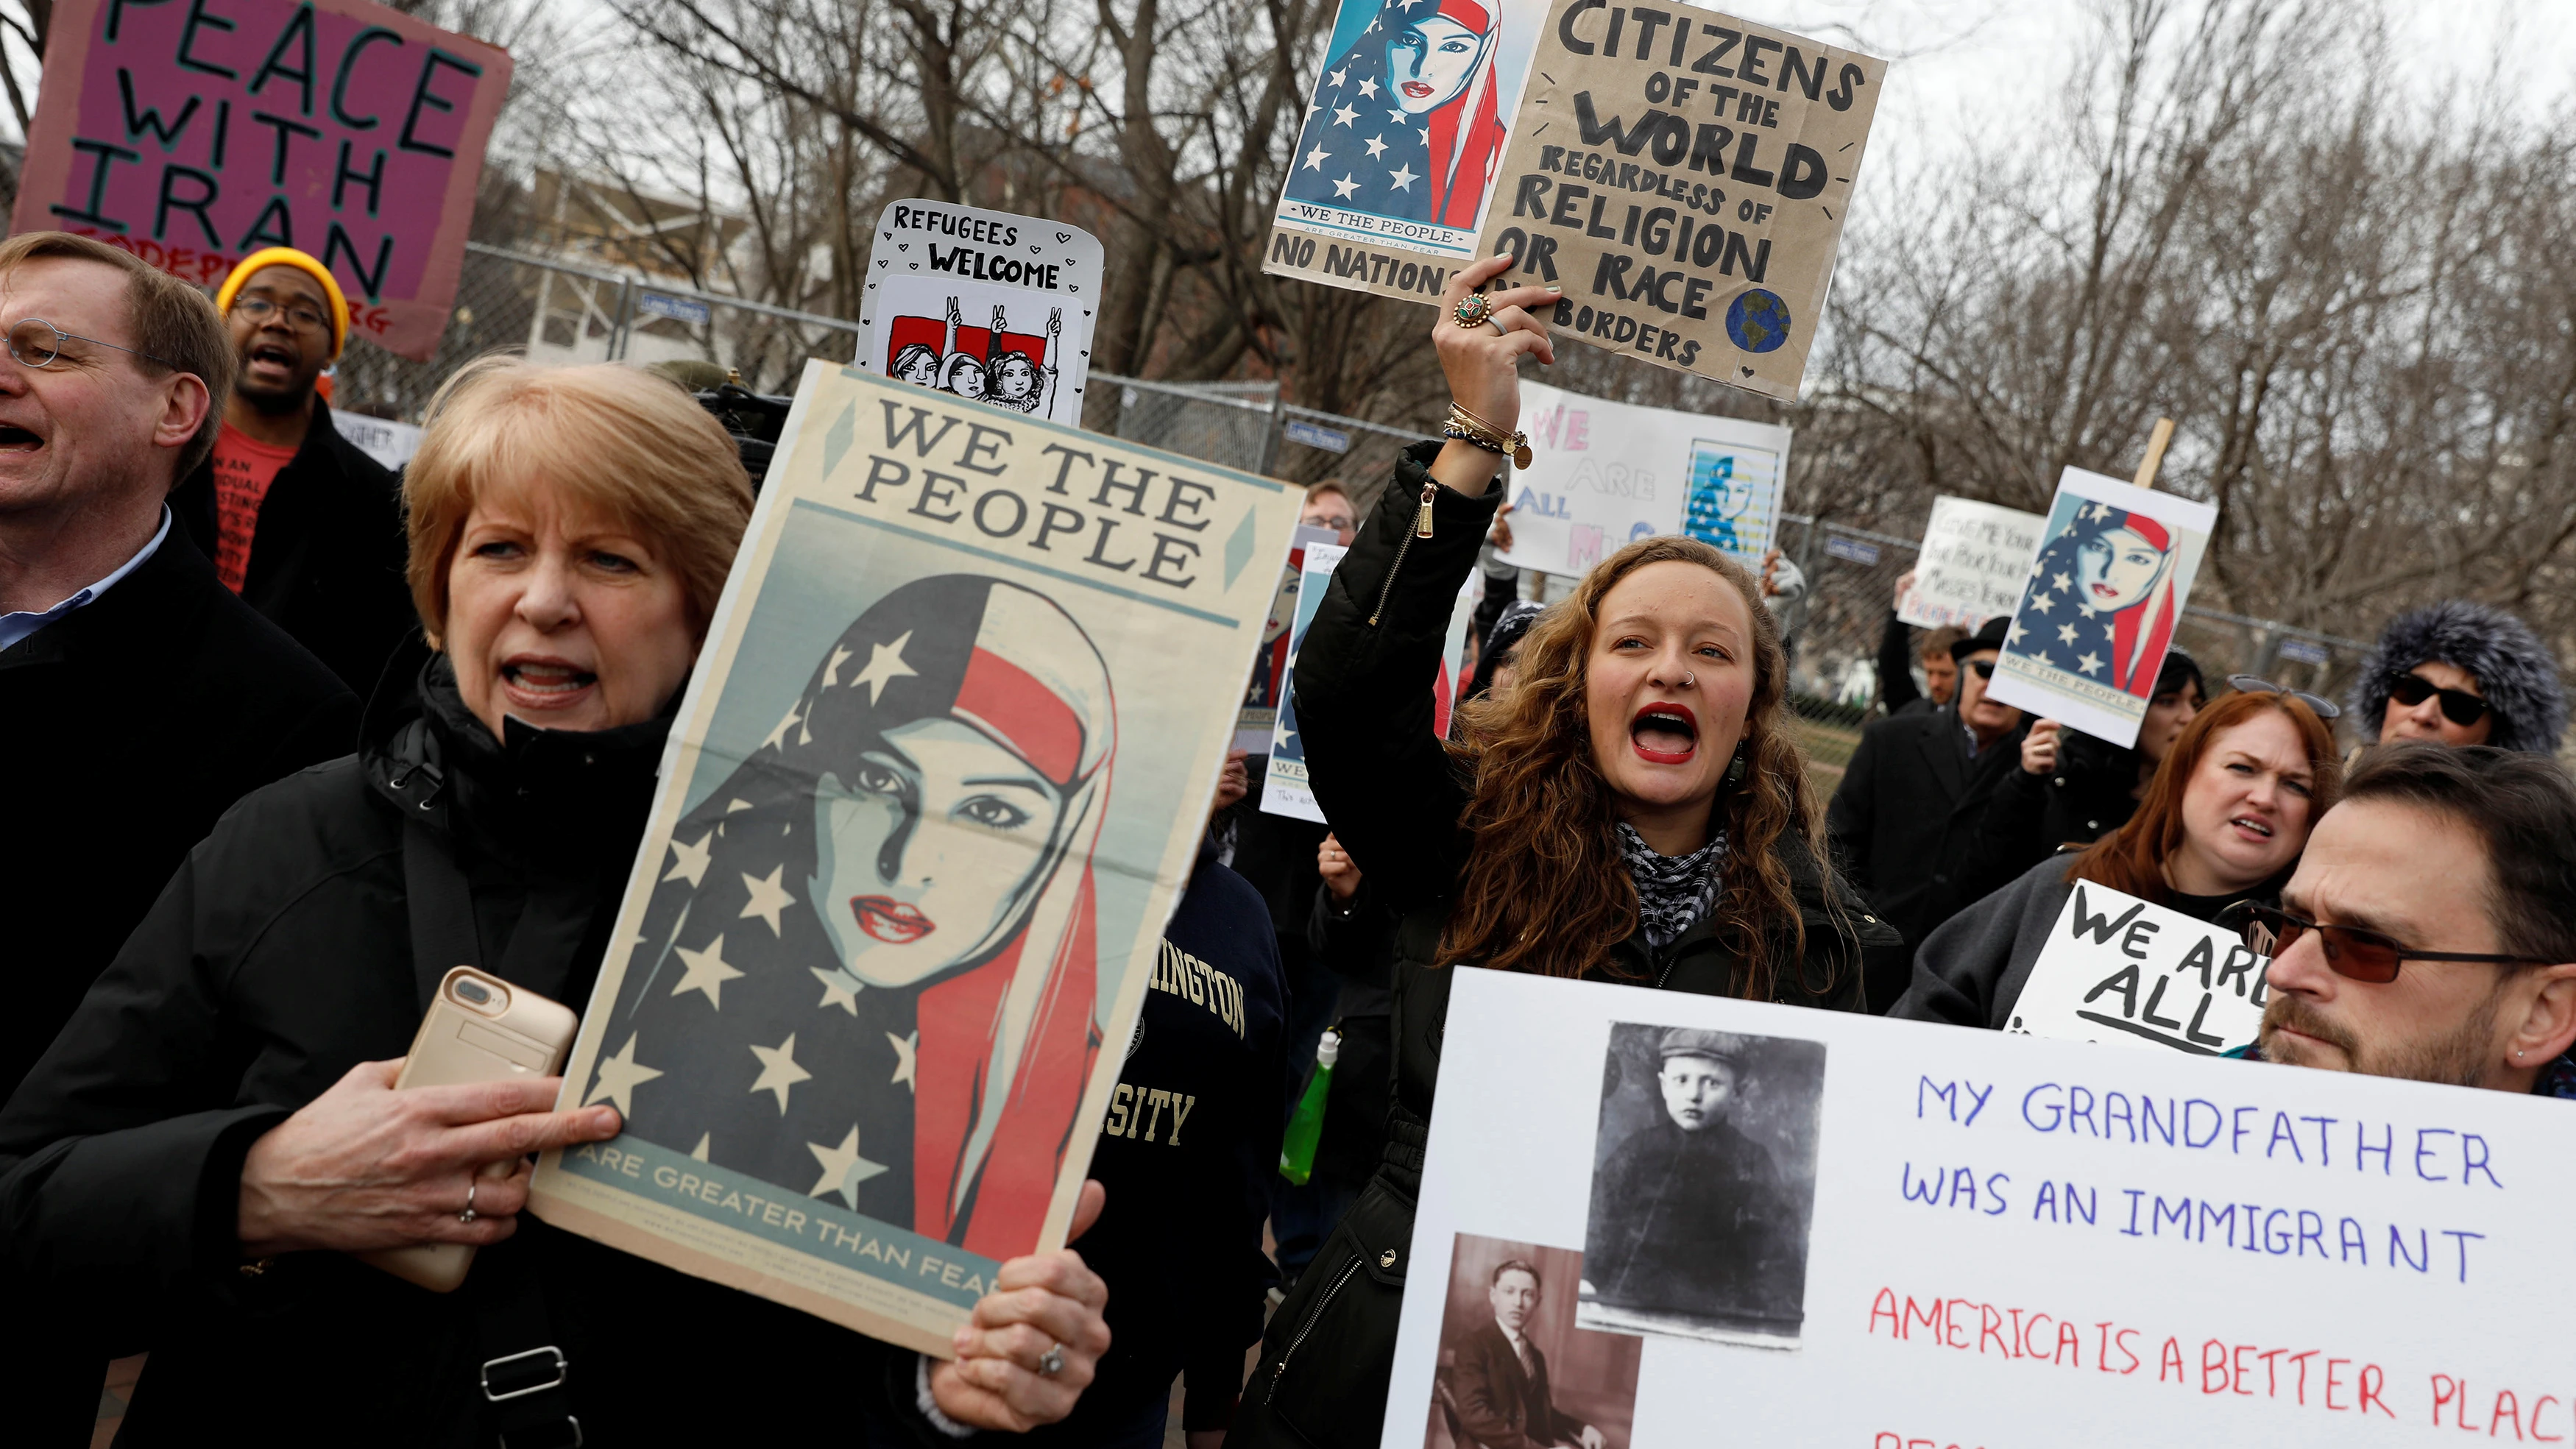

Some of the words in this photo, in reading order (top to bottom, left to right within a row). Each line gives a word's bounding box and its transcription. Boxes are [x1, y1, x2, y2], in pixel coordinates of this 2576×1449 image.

[1558, 0, 1866, 112] CITIZENS
[1644, 71, 1698, 108] OF
[1709, 84, 1780, 130] THE
[116, 68, 387, 218] WITH
[1573, 91, 1828, 200] WORLD
[49, 137, 394, 305] IRAN
[1539, 144, 1727, 216] REGARDLESS
[1738, 197, 1773, 225] OF
[894, 205, 1018, 247] REFUGEES
[1301, 205, 1331, 222] WE
[1337, 212, 1374, 229] THE
[1380, 220, 1454, 243] PEOPLE
[1304, 227, 1324, 235] ARE
[1328, 230, 1375, 244] GREATER
[1380, 238, 1408, 248] THAN
[1412, 246, 1440, 255] FEAR
[1512, 173, 1772, 283] RELIGION
[928, 243, 1060, 290] WELCOME
[1271, 233, 1316, 269] NO
[1323, 244, 1461, 297] NATION
[1553, 296, 1702, 366] BORDERS
[1494, 226, 1559, 283] OR
[1593, 252, 1713, 321] RACE
[1533, 405, 1589, 451] WE
[216, 474, 260, 494] IDUAL
[219, 492, 263, 513] STING
[878, 399, 1014, 477] WE
[1041, 442, 1217, 533] THE
[1512, 486, 1571, 520] ALL
[1565, 458, 1656, 501] ARE
[854, 454, 1202, 590] PEOPLE
[1979, 519, 2000, 546] ME
[2003, 524, 2034, 551] YOUR
[1920, 567, 1976, 601] MASSES
[1979, 581, 2020, 610] YEARN
[2006, 656, 2031, 671] WE
[2038, 666, 2068, 683] THE
[2073, 679, 2137, 709] PEOPLE
[1276, 762, 1306, 776] WE
[2073, 885, 2160, 960] WE
[2084, 964, 2225, 1046] ALL
[1104, 1083, 1195, 1146] SITY
[1917, 1075, 1994, 1127] MY
[2022, 1083, 2504, 1190] GRANDFATHER
[576, 1144, 643, 1179] ARE
[653, 1165, 807, 1233] GREATER
[816, 1219, 912, 1270] THAN
[1901, 1161, 2011, 1214] WAS
[2034, 1180, 2098, 1227] AN
[2121, 1188, 2486, 1284] IMMIGRANT
[1868, 1287, 2080, 1369] AMERICA
[2095, 1321, 2141, 1376] IS
[2159, 1336, 2185, 1385] A
[2201, 1339, 2396, 1419] BETTER
[2430, 1372, 2576, 1446] PLAC
